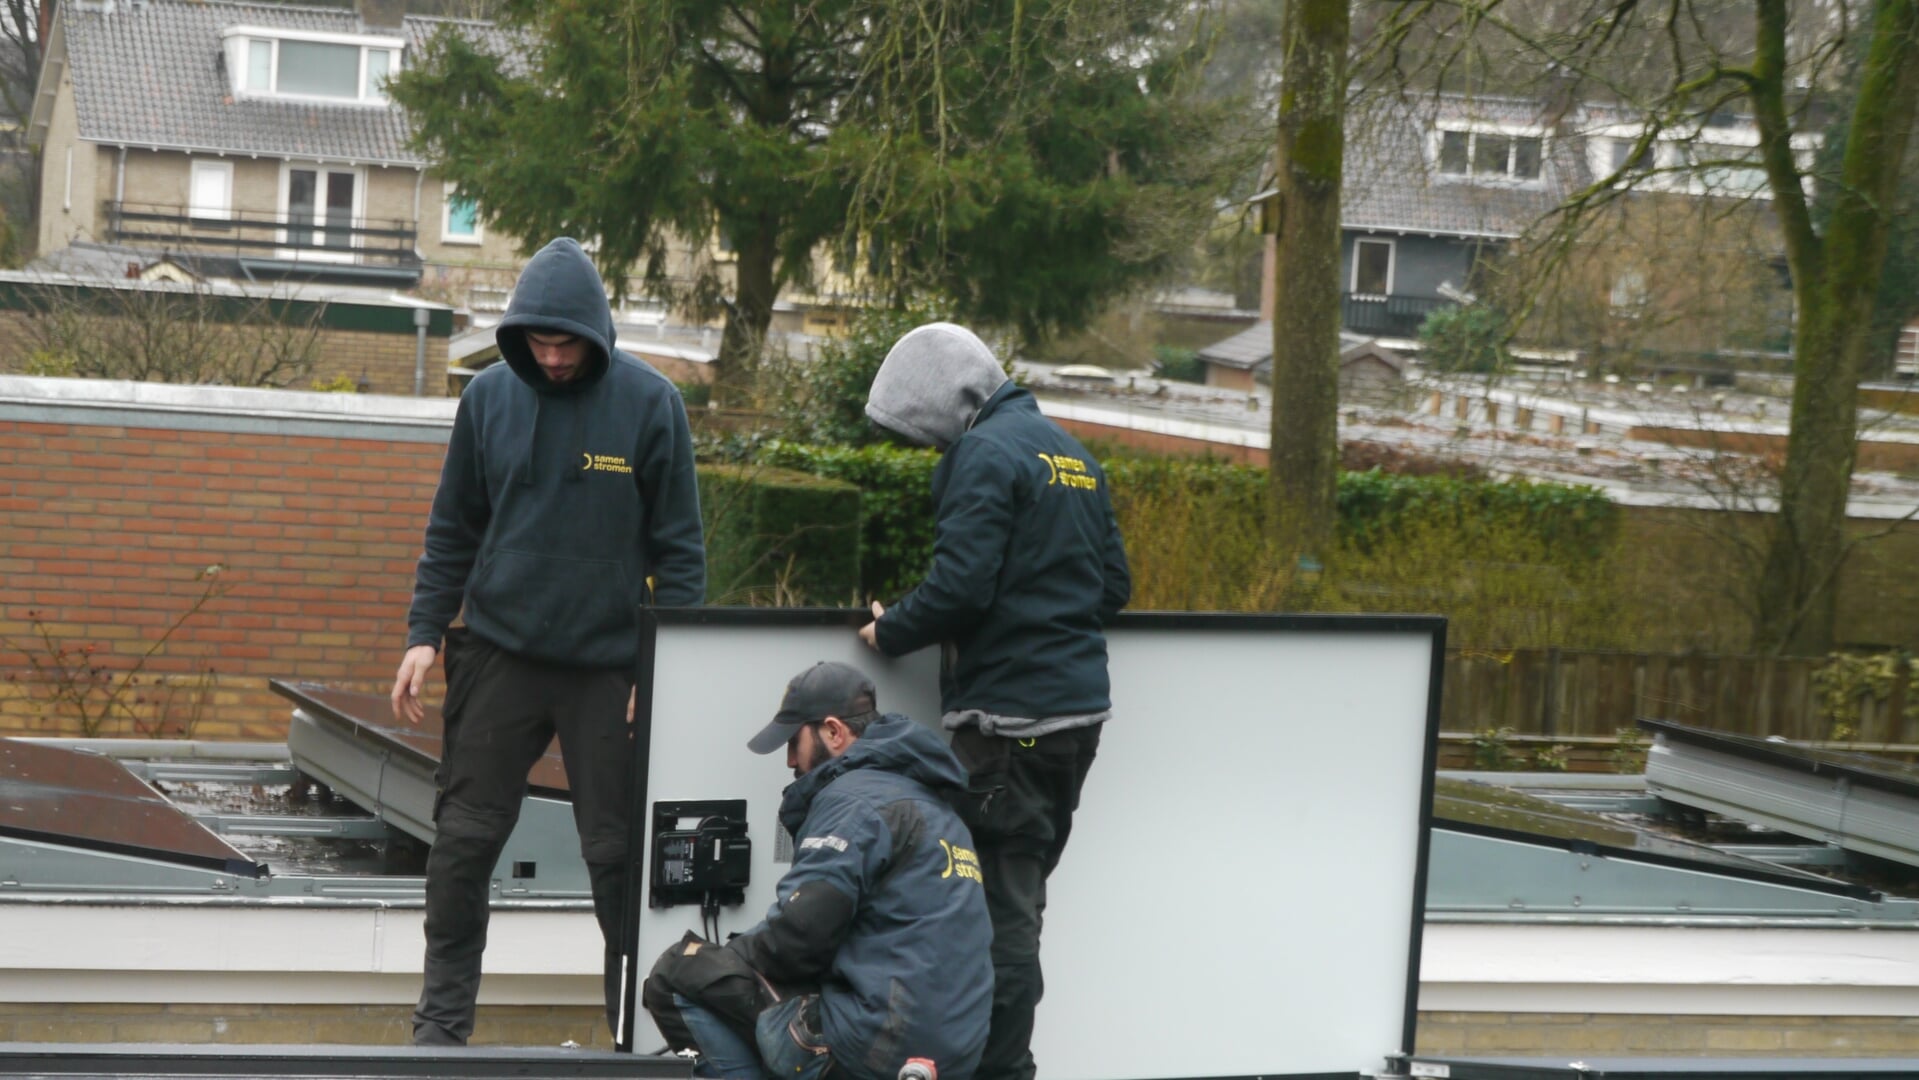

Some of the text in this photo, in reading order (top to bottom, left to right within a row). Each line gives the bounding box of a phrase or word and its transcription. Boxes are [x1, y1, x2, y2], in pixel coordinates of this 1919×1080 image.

[594, 455, 625, 465] samen
[1053, 455, 1087, 473] samen
[593, 462, 632, 473] stromen
[1059, 470, 1097, 491] stromen
